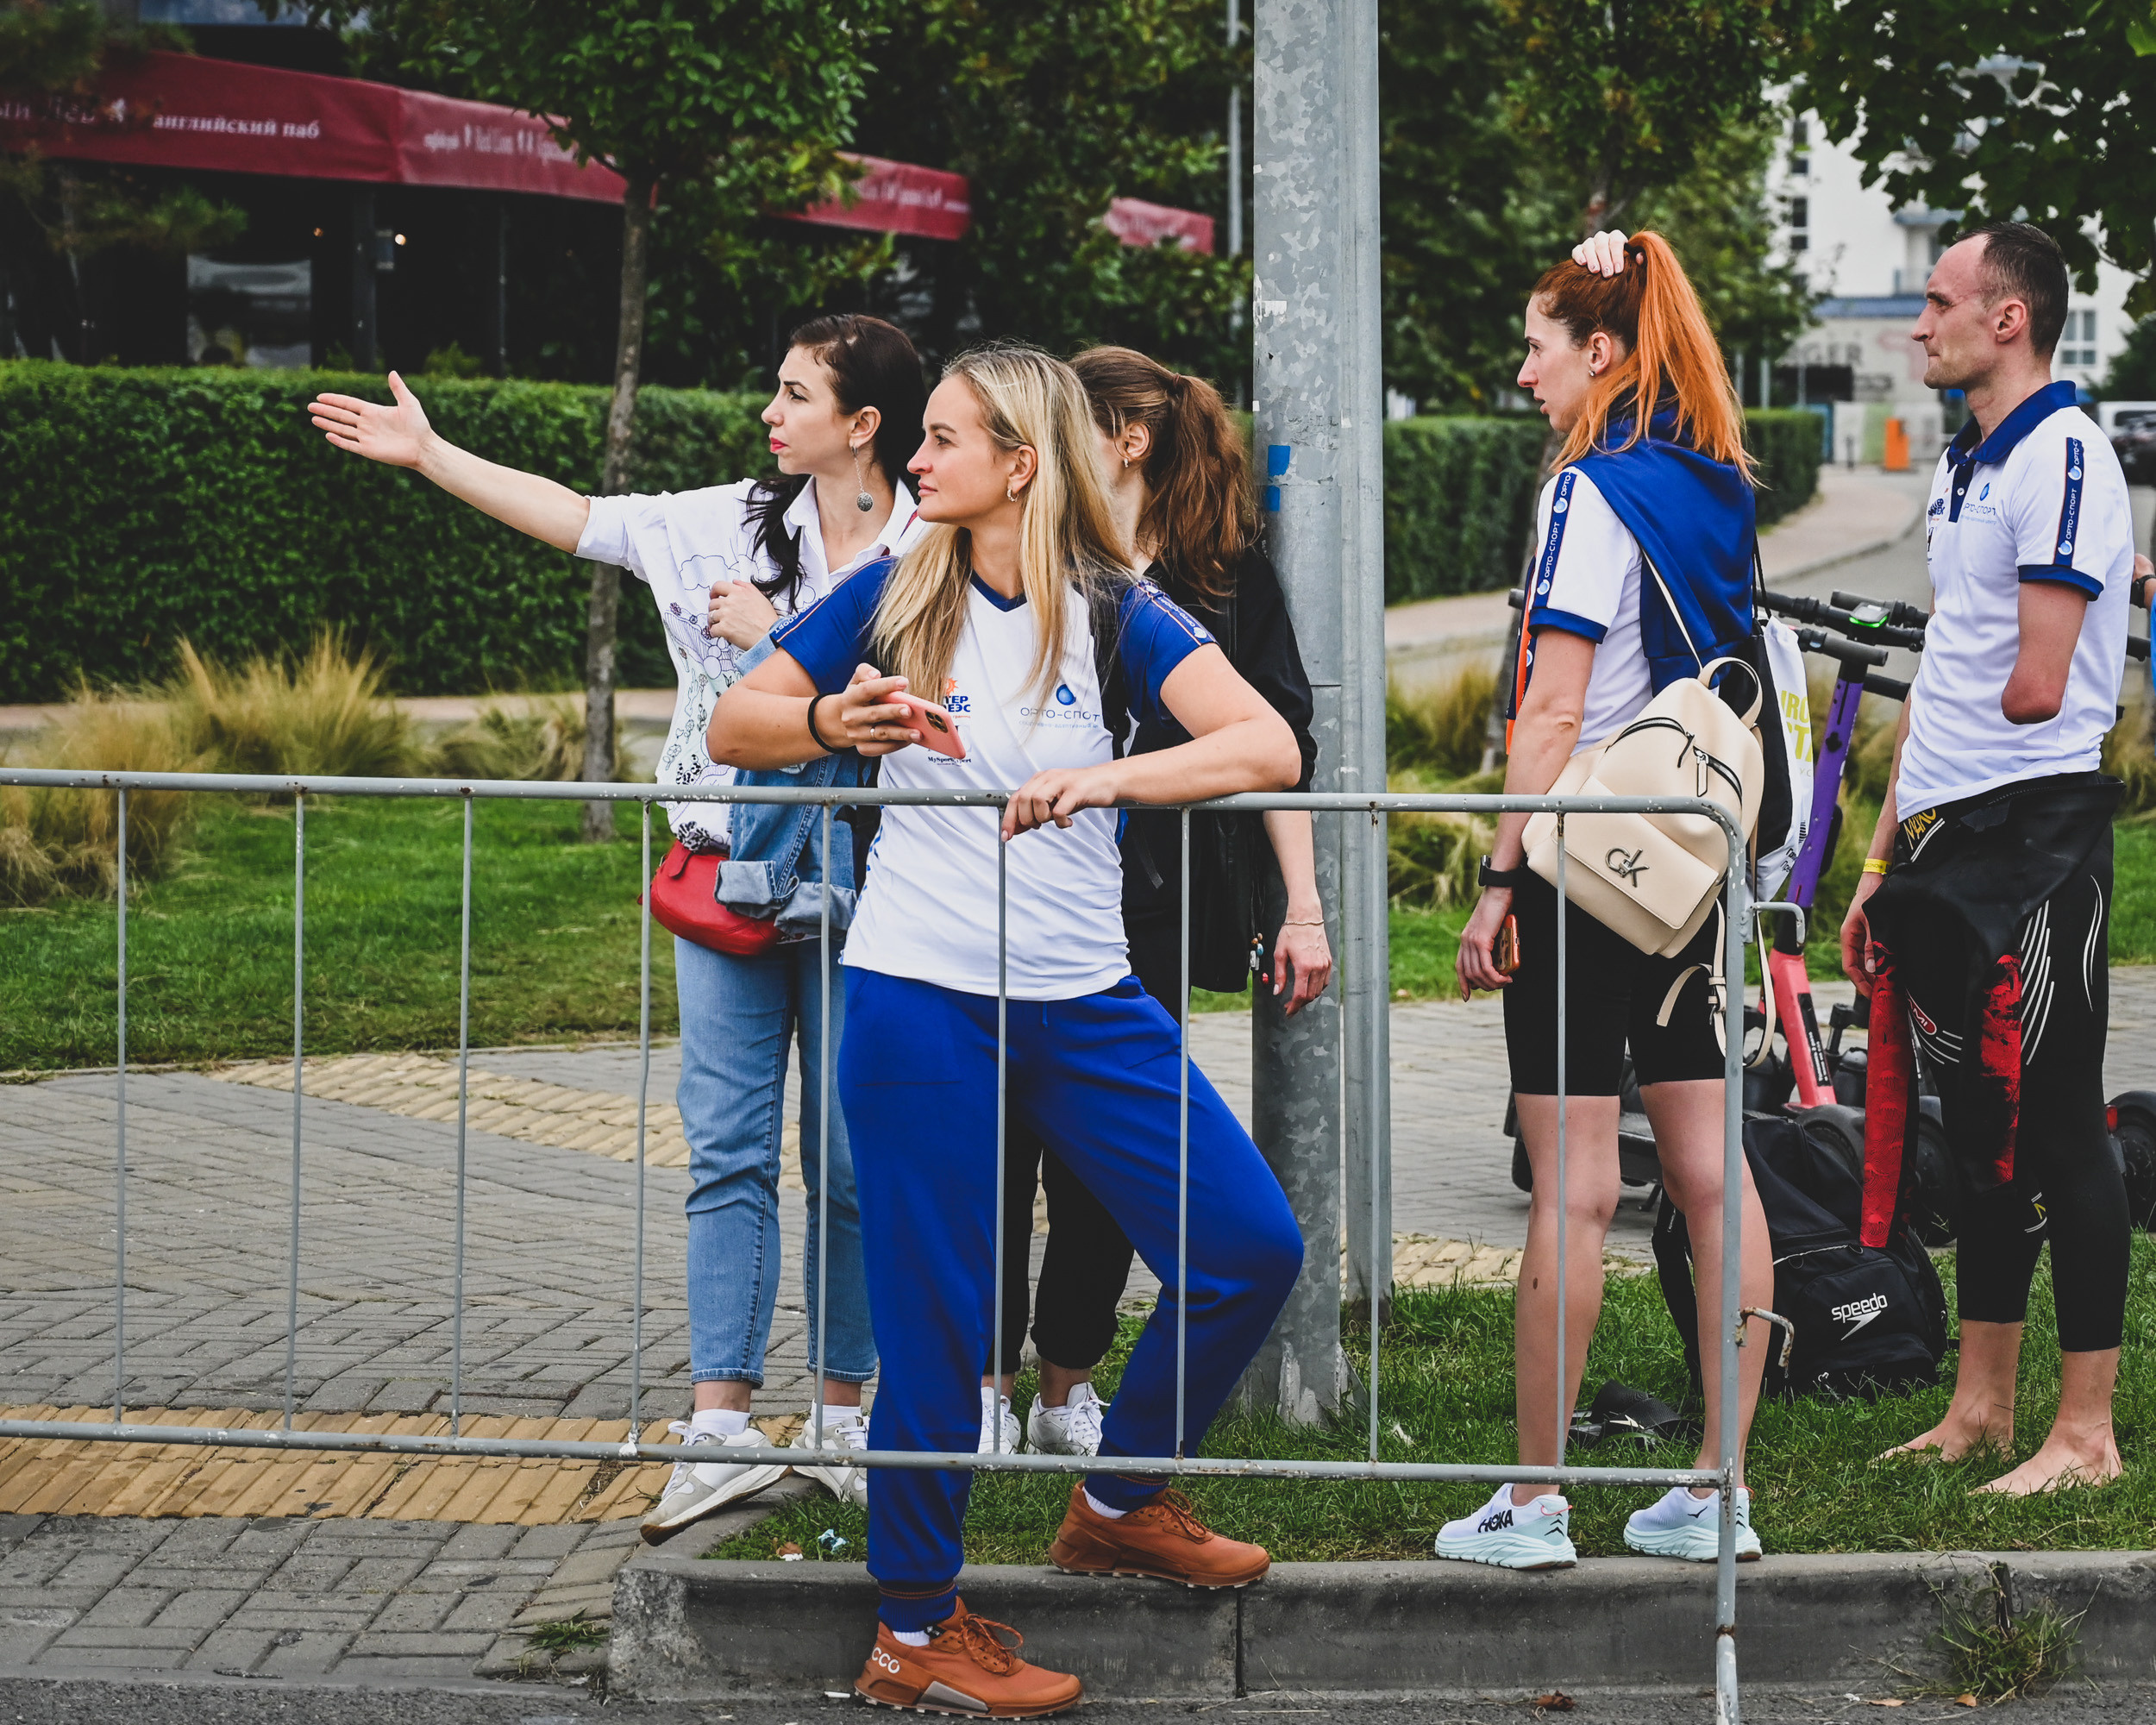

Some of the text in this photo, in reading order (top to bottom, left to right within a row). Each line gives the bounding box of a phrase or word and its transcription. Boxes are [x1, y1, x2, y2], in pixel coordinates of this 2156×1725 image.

[153, 113, 278, 136] английский
[282, 119, 320, 139] паб
[2065, 487, 2078, 541] ОРТО-СПОРТ
[1544, 521, 1561, 579] ОРТО-СПОРТ
[1831, 1292, 1889, 1324] speedo
[1477, 1509, 1514, 1534] HOKA
